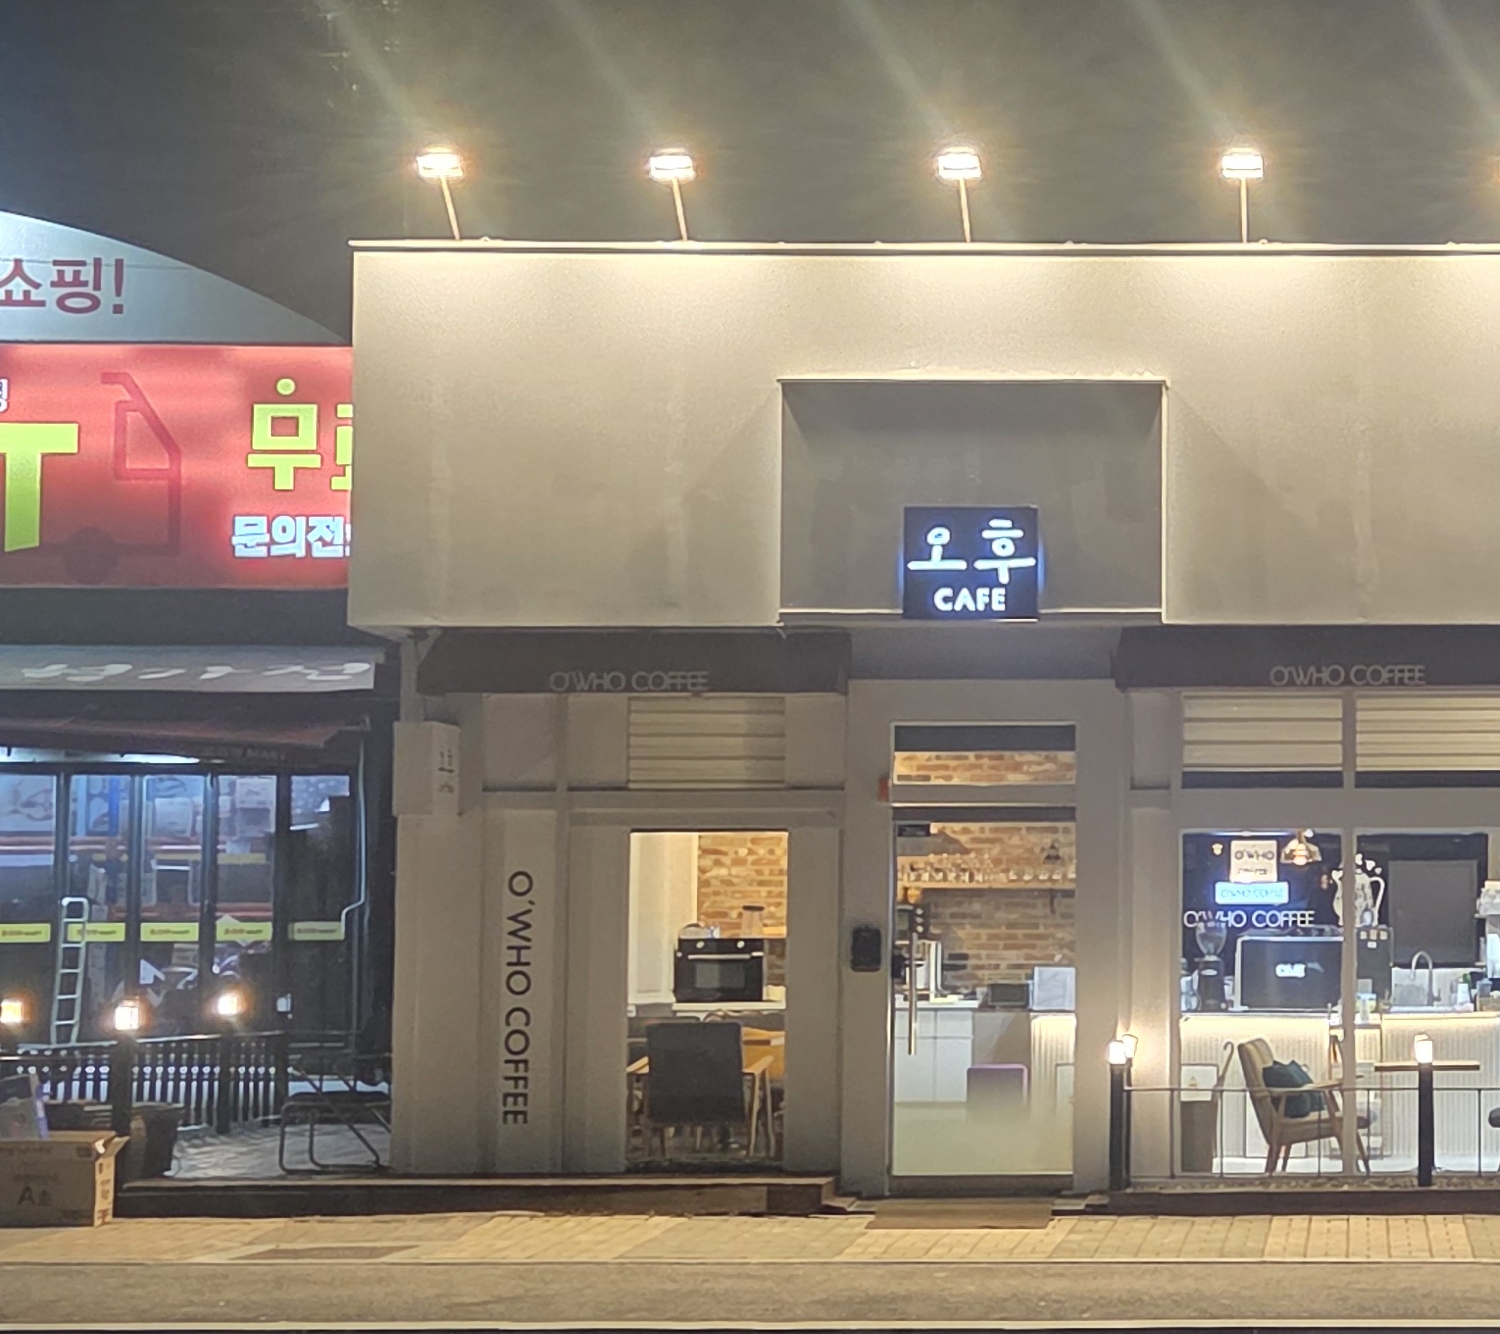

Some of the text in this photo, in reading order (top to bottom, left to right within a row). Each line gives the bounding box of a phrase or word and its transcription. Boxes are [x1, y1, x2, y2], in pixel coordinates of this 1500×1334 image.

[231, 514, 352, 558] 문의전
[907, 518, 1037, 585] 오후
[933, 587, 1006, 612] CAFE
[631, 671, 709, 691] COFFEE
[1350, 665, 1426, 685] COFFEE
[1251, 910, 1316, 928] COFFEE
[502, 871, 535, 1125] O'WHO COFFEE
